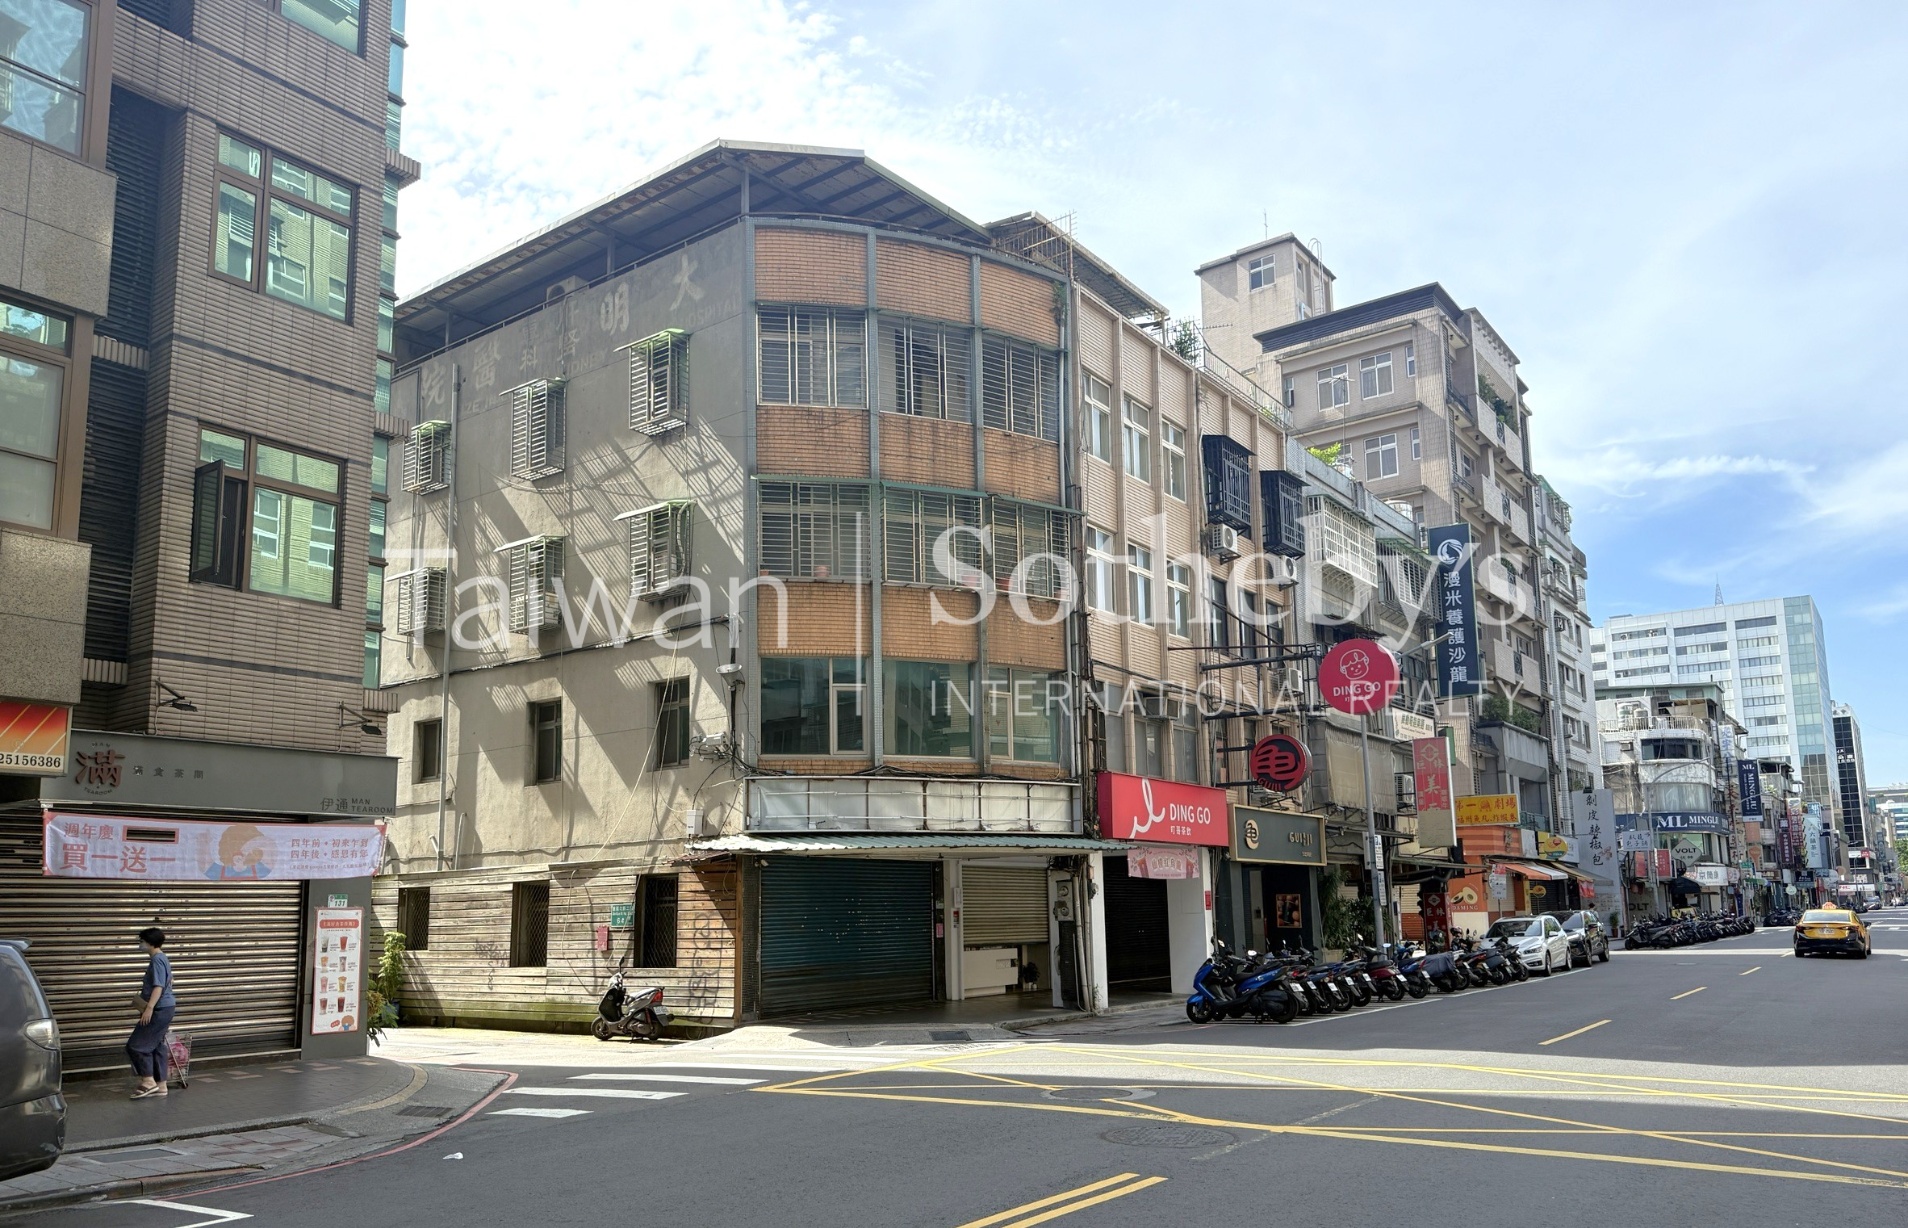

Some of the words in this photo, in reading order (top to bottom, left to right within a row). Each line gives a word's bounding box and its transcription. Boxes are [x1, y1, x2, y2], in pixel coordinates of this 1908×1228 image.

[1332, 684, 1361, 697] DING
[1363, 681, 1381, 693] GO
[75, 750, 125, 787] 滿
[320, 797, 349, 812] 伊通
[351, 805, 393, 814] TEAROOM
[1169, 803, 1195, 822] DING
[1196, 806, 1211, 825] GO
[1657, 815, 1688, 828] ML
[64, 822, 114, 841] 週年慶
[291, 838, 320, 848] 四年前
[59, 843, 176, 873] 買一送一
[290, 849, 320, 859] 四年後
